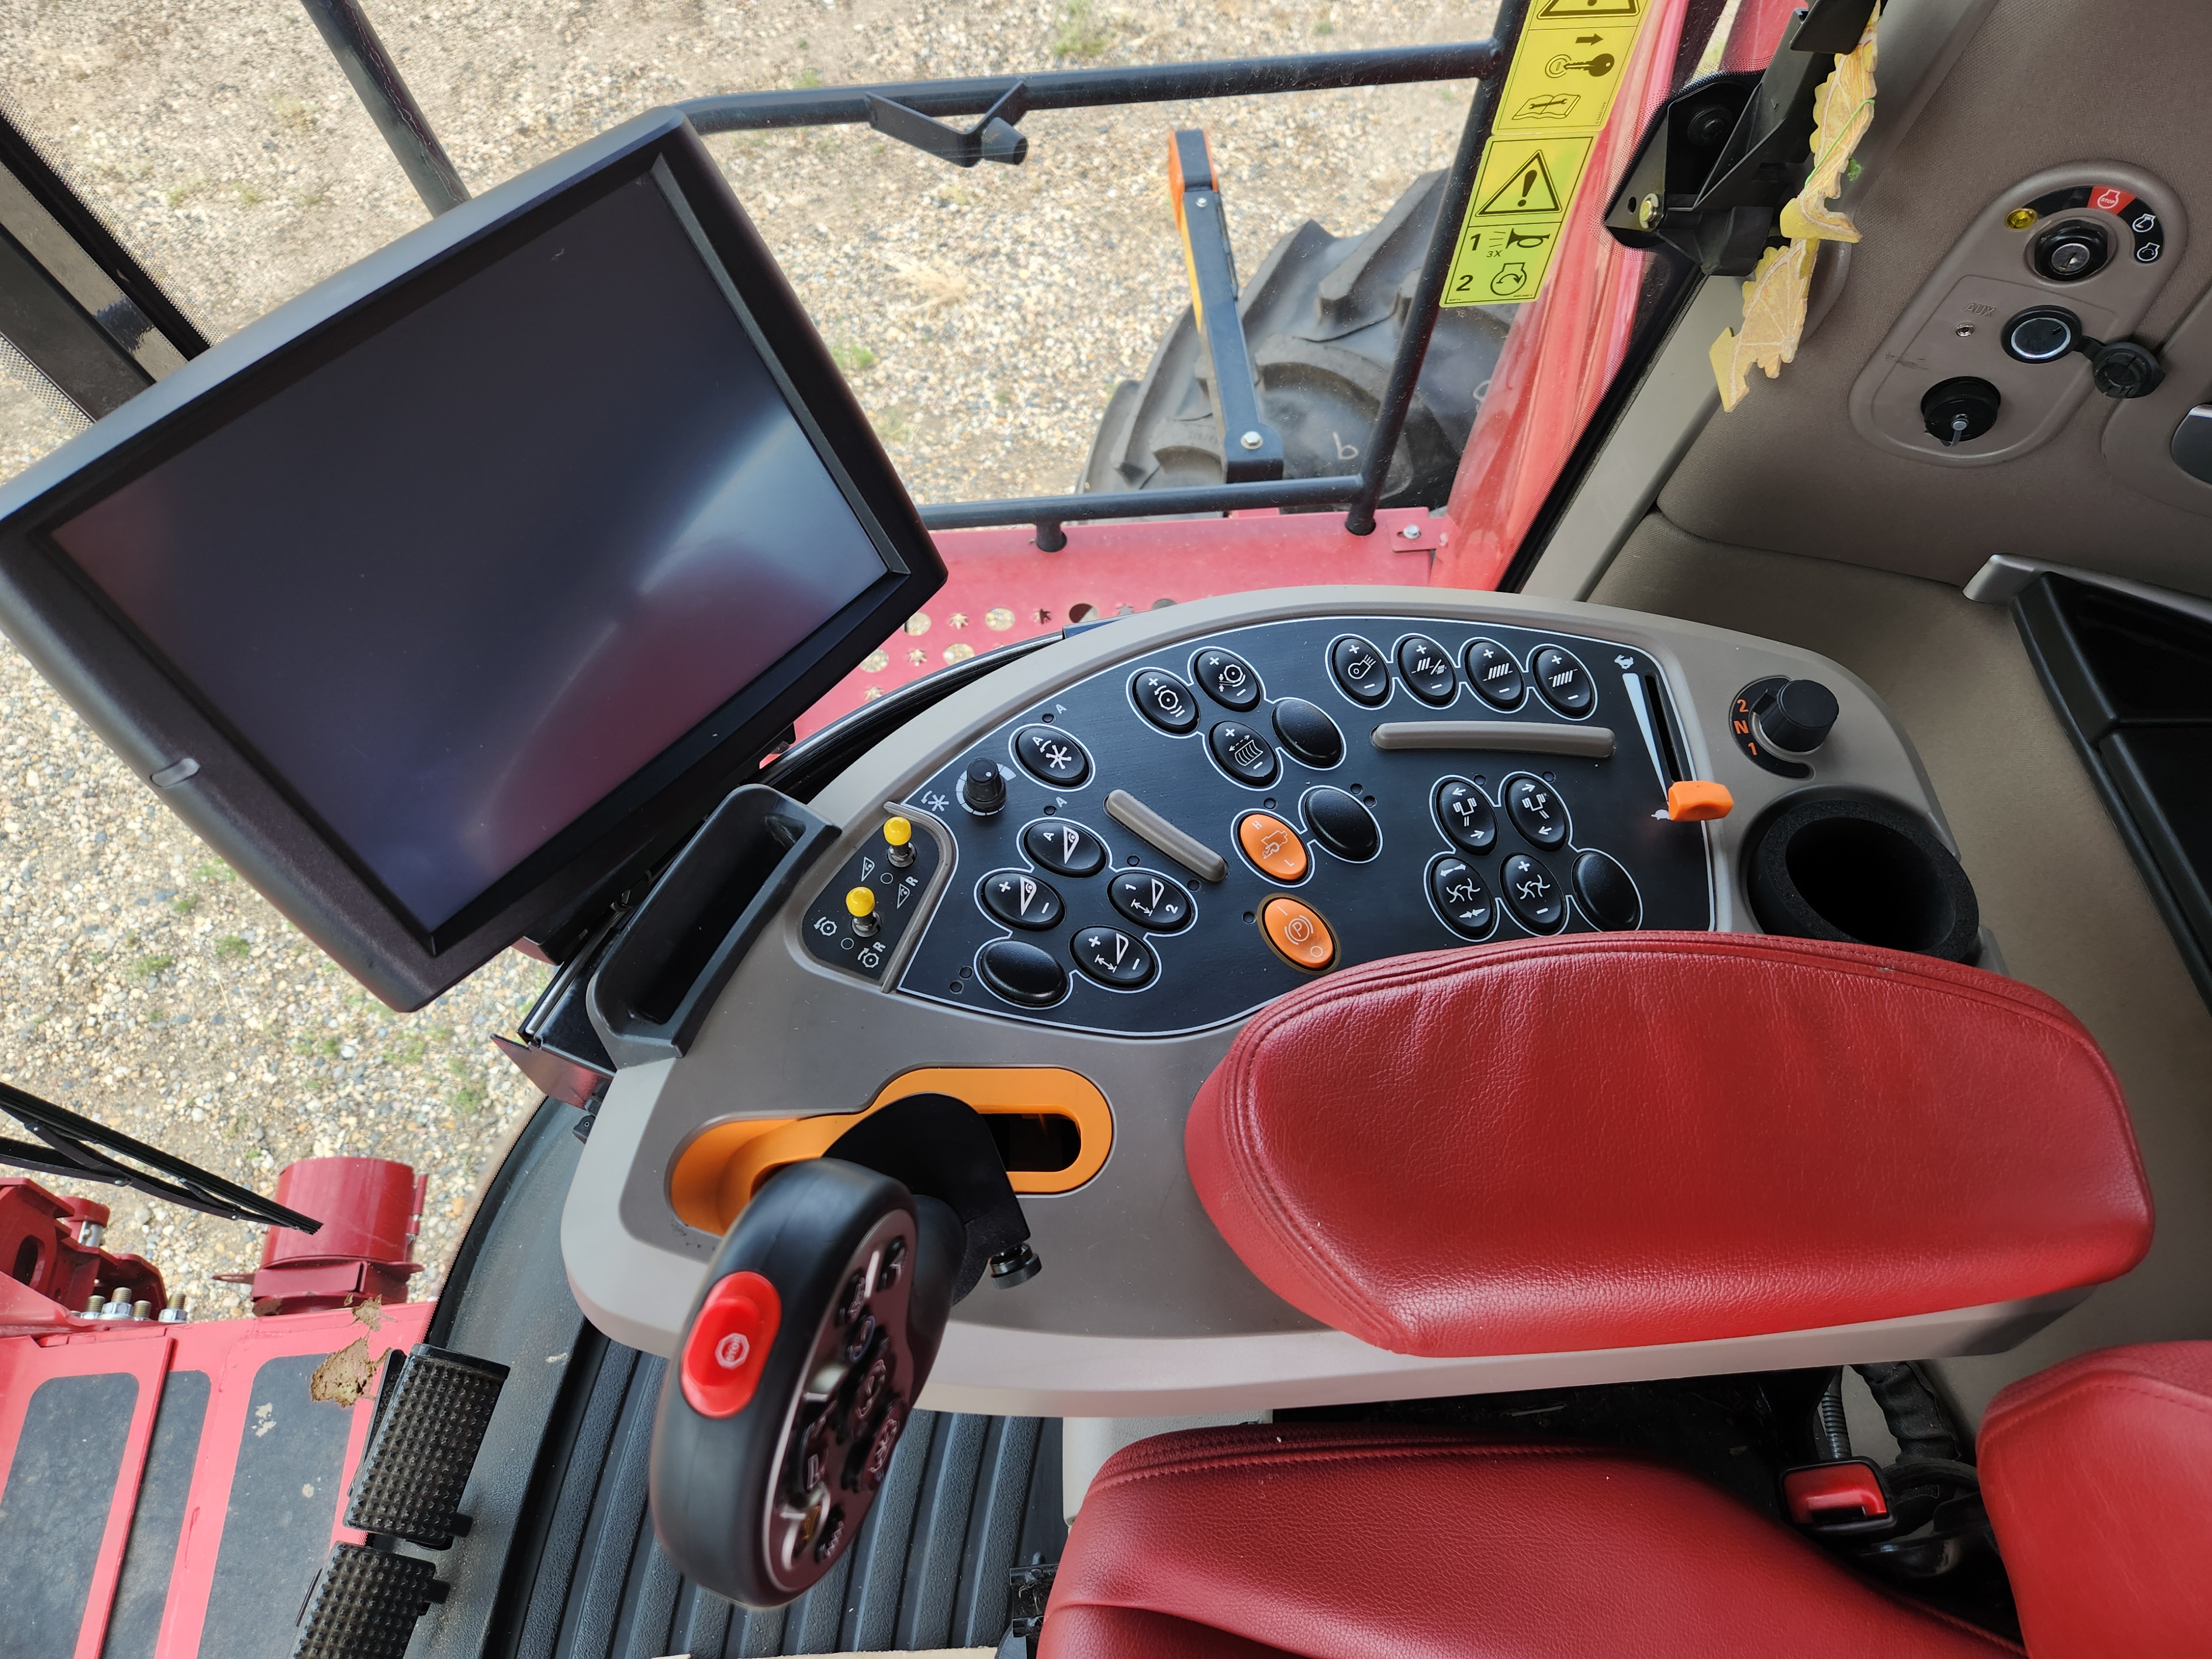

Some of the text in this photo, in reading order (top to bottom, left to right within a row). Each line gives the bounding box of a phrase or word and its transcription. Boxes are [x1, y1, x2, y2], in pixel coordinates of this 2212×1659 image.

[1470, 233, 1481, 251] 1
[1486, 249, 1503, 258] 3X
[1455, 274, 1474, 292] 2
[1963, 302, 1996, 317] AUX
[1055, 703, 1067, 714] A
[1736, 698, 1749, 713] 2
[1734, 720, 1749, 735] N
[1032, 736, 1044, 746] A
[1747, 741, 1758, 756] 1
[1055, 796, 1068, 808] A
[1251, 820, 1263, 830] H
[1042, 831, 1055, 842] A
[1284, 858, 1295, 868] L
[905, 875, 919, 887] R
[1165, 904, 1178, 915] 2
[1292, 921, 1303, 937] P
[873, 941, 886, 953] R
